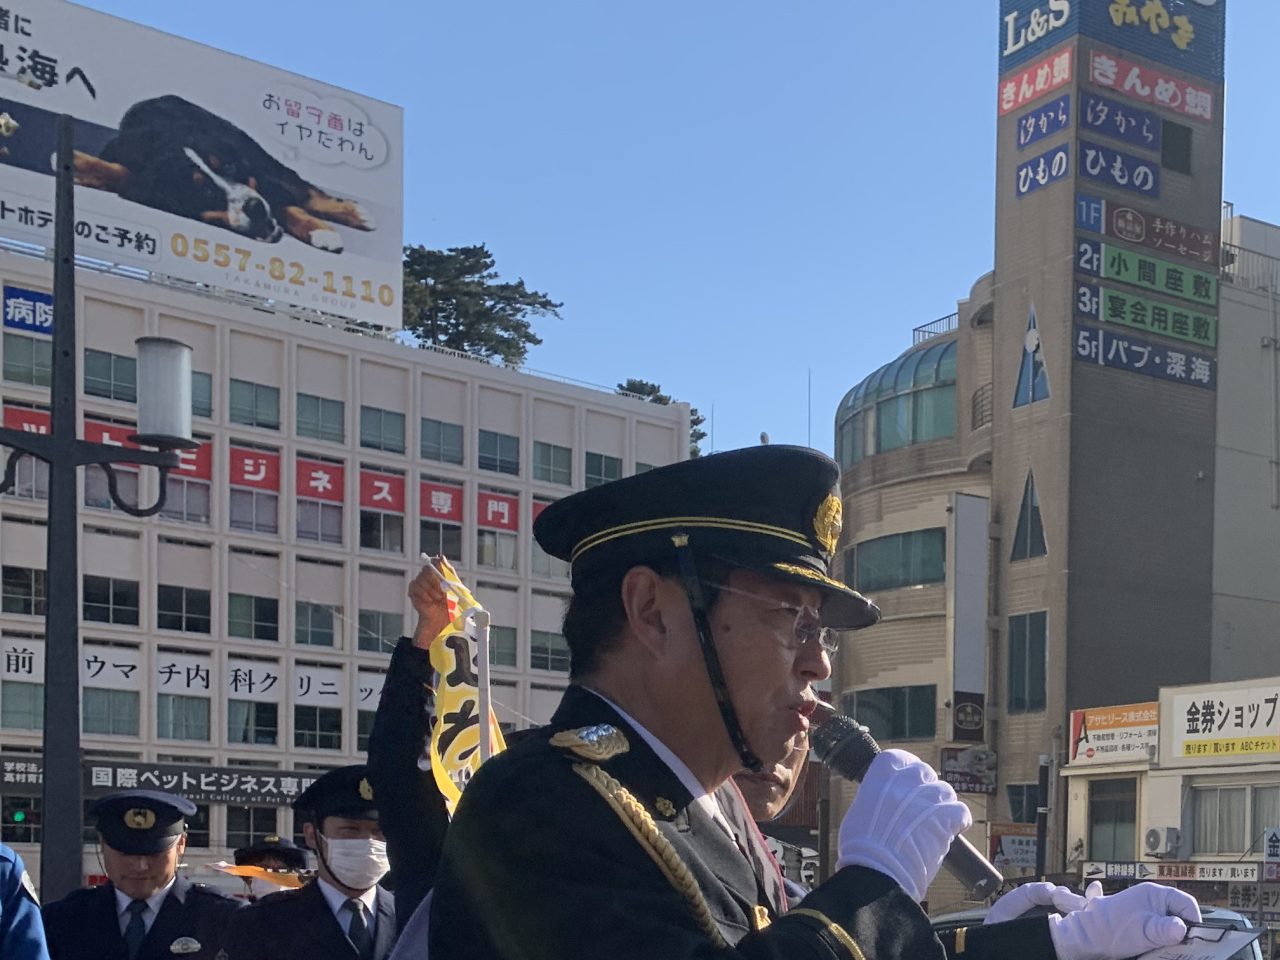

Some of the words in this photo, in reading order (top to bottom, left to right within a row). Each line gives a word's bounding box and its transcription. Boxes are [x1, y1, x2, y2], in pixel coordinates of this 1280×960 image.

[1019, 151, 1067, 193] ひもの
[1086, 149, 1154, 190] ひもの
[0, 200, 157, 255] トホテのご予約
[170, 232, 394, 307] 0557-82-1110
[1079, 243, 1100, 271] 2F
[1109, 252, 1212, 301] 小間座敷
[1078, 286, 1099, 315] 3F
[1108, 295, 1211, 342] 宴会用座敷
[1077, 331, 1098, 359] 5F
[1186, 693, 1279, 735] 金券ショップ
